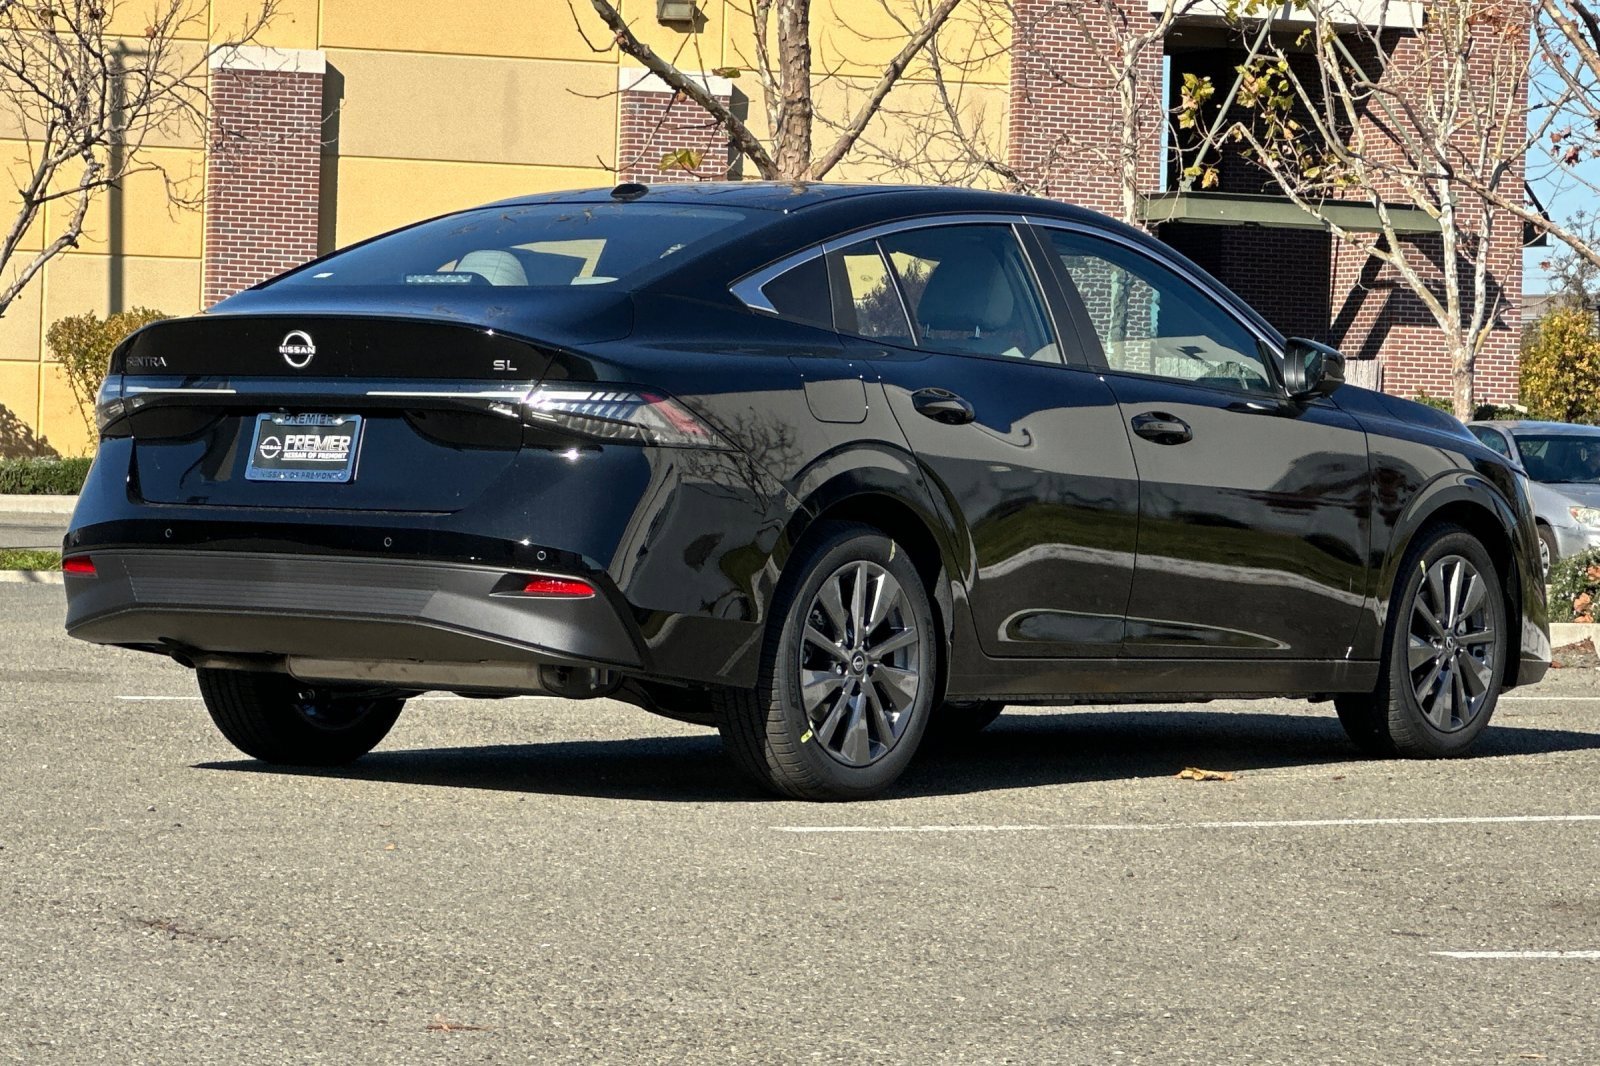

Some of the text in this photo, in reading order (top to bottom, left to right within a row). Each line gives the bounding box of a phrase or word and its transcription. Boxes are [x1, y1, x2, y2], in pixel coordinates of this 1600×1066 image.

[278, 345, 316, 354] NISSAN
[126, 356, 167, 368] SENTRA
[493, 359, 518, 371] SL
[284, 413, 334, 425] PREMIER
[284, 434, 351, 451] PREMIER
